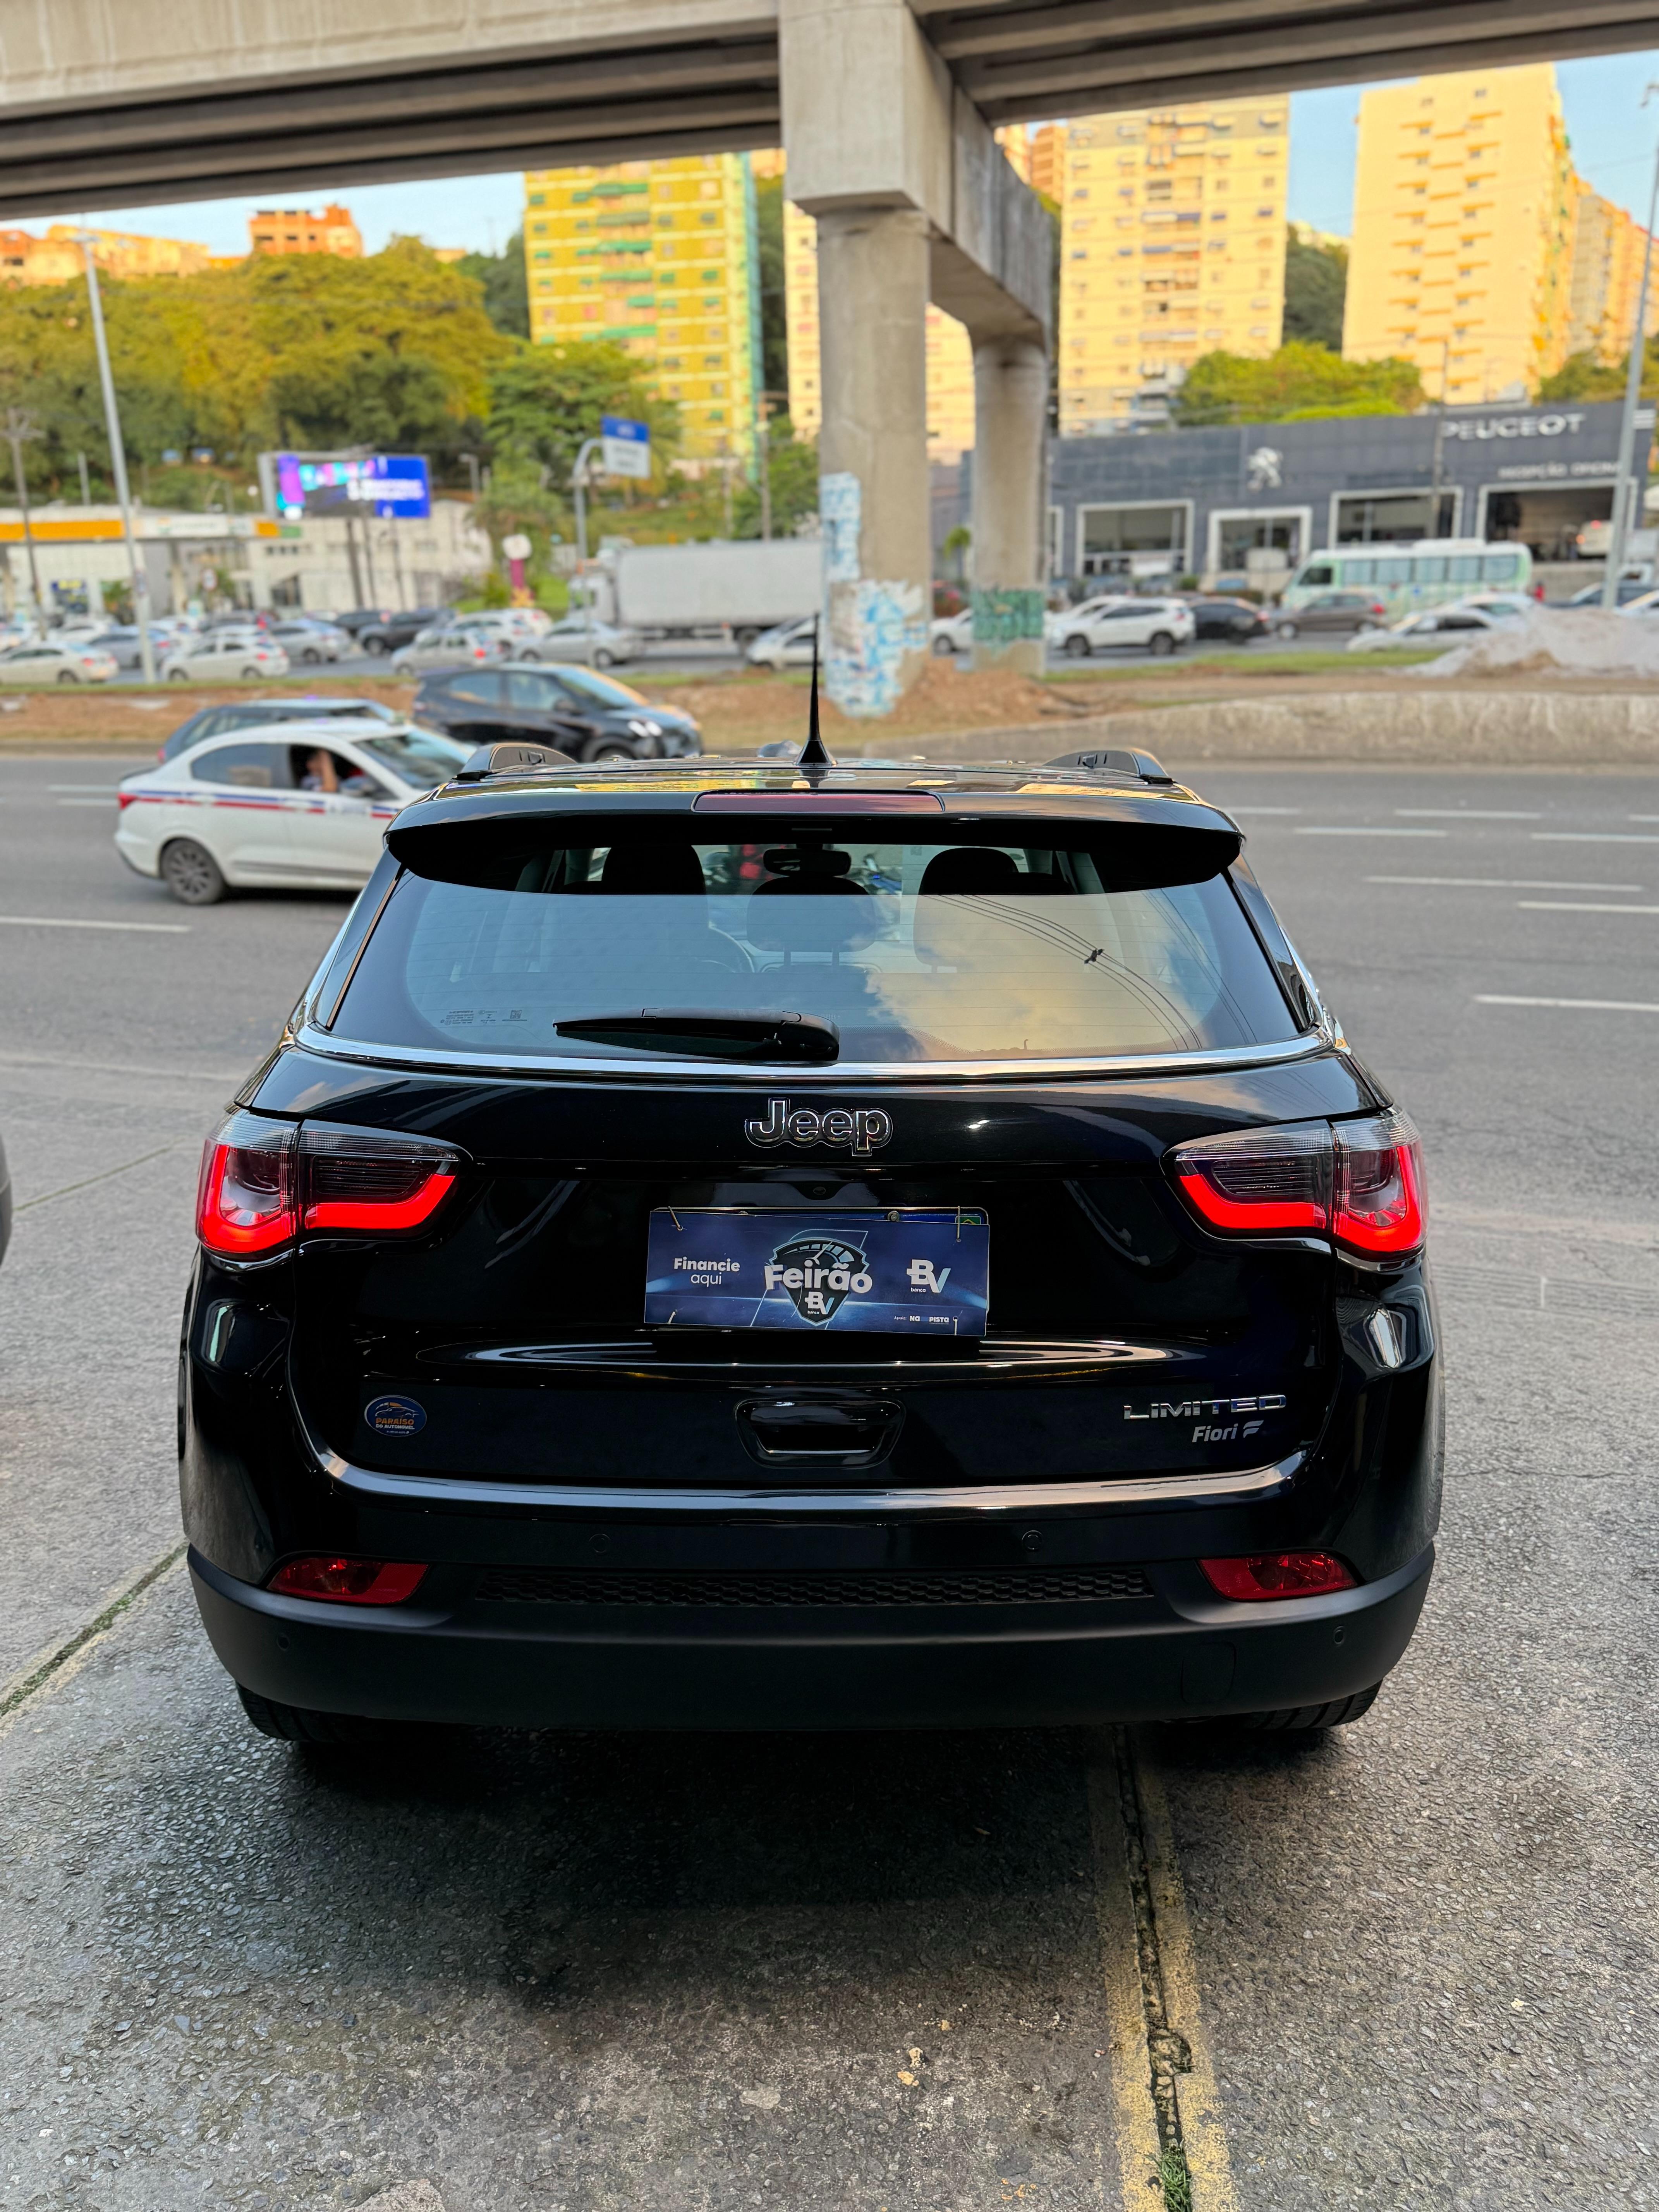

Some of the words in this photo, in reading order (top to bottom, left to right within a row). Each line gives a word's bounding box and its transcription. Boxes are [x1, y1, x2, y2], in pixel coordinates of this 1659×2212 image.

[745, 1097, 893, 1156] Jeep
[674, 1256, 740, 1272] Financie
[690, 1272, 721, 1287] aqui
[764, 1262, 872, 1293] Feirão
[1124, 1395, 1286, 1419] LIMITED
[1192, 1423, 1238, 1443] Fiori
